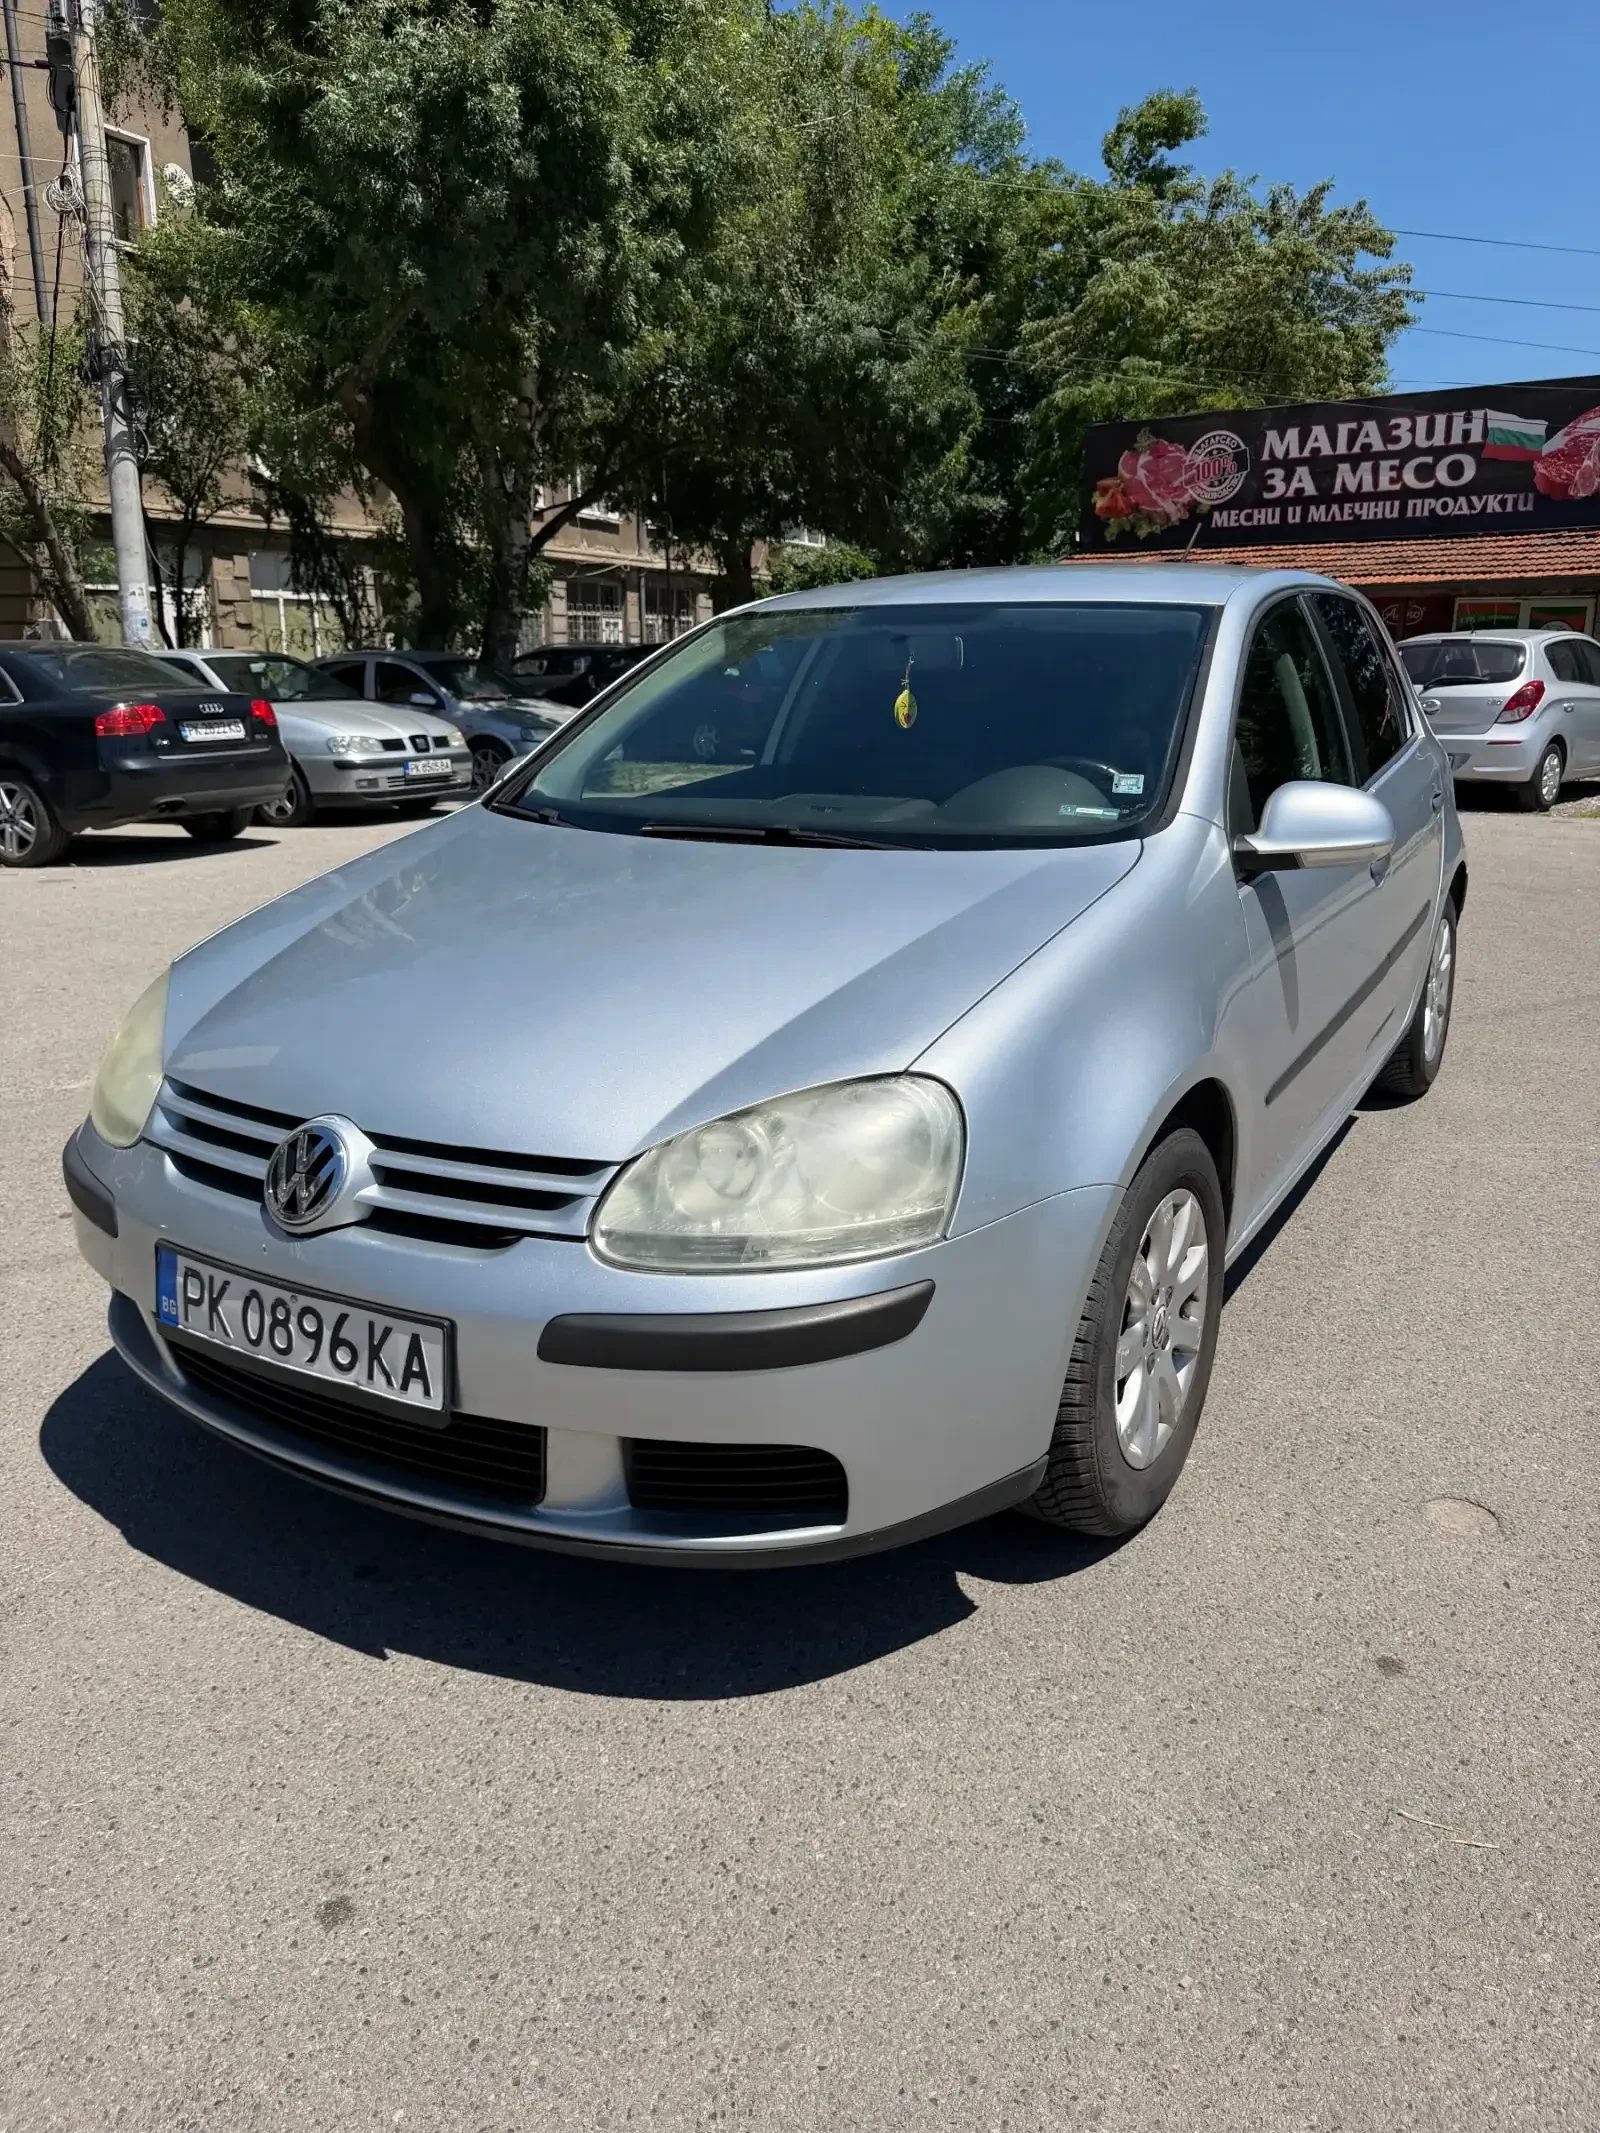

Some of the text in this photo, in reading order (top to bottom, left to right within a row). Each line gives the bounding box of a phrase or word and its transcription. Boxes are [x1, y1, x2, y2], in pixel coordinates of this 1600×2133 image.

[1260, 410, 1485, 461] МАГАЗИН
[1193, 452, 1238, 482] 100%
[1262, 453, 1477, 499] ЗА МЕСО
[1210, 493, 1536, 528] МЕСНИ И МЛЕЧНИ ПРОДУКТИ
[161, 1296, 177, 1316] BG
